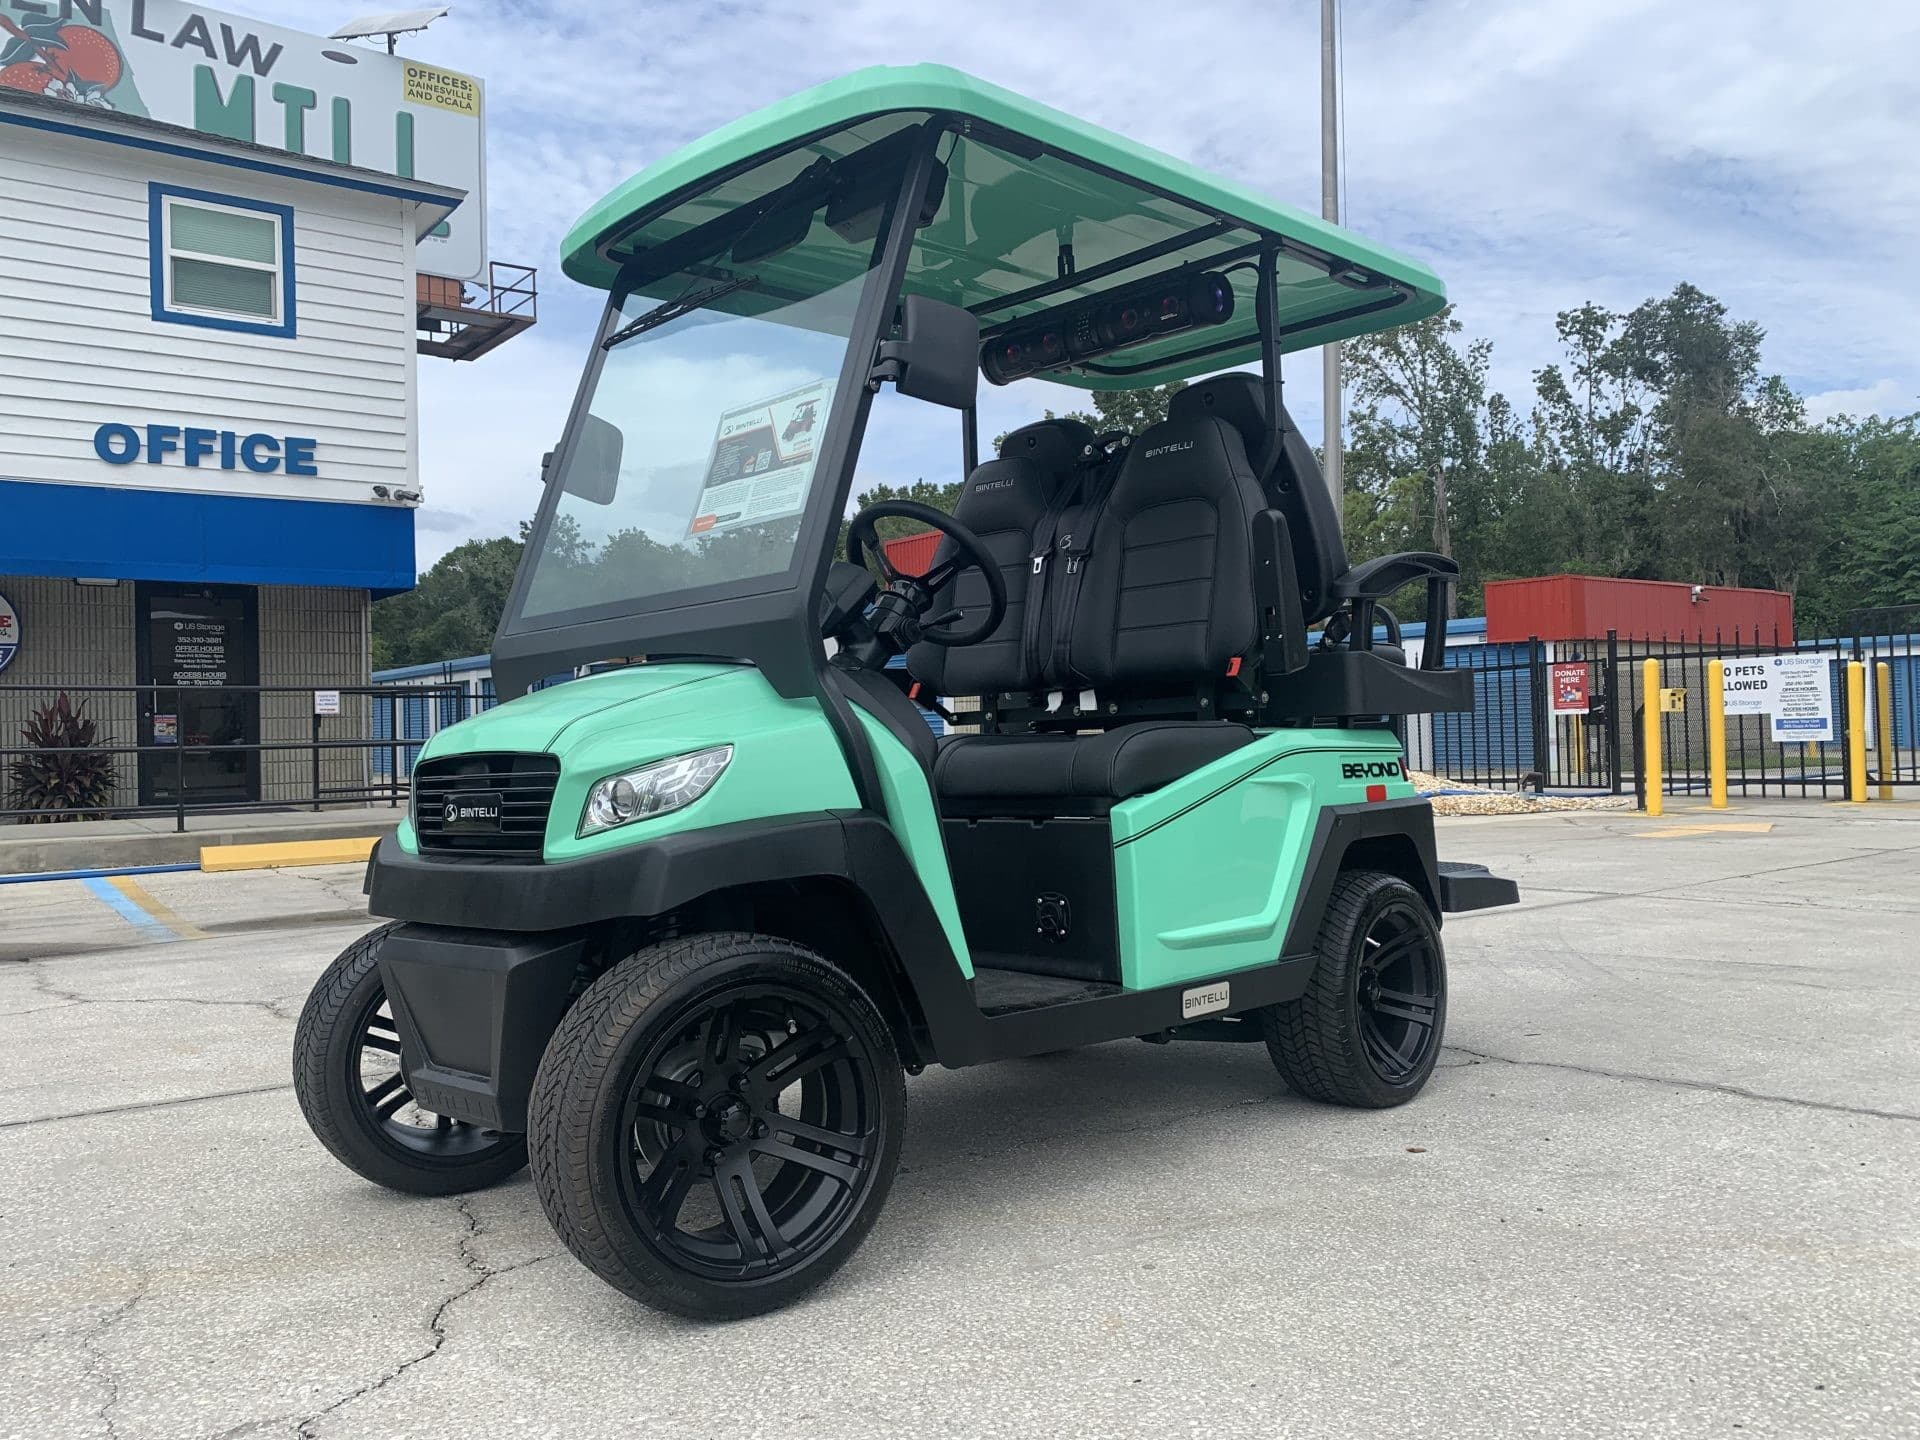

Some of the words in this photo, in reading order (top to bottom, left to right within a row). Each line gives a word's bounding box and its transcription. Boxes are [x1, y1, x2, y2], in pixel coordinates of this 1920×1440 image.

[131, 0, 283, 77] LAW
[407, 67, 472, 92] OFFICES:
[408, 79, 473, 101] GAINESVILLE
[407, 88, 432, 101] AND
[435, 95, 473, 111] OCALA
[94, 422, 318, 476] OFFICE
[1145, 440, 1194, 458] BINTELLI
[975, 479, 1015, 492] BINTELLI
[197, 623, 225, 632] Storage
[173, 671, 201, 679] ACCESS
[1555, 669, 1585, 677] DONATE
[1735, 665, 1765, 676] PETS
[1560, 676, 1580, 684] HERE
[1341, 762, 1399, 779] BEYOND
[460, 807, 498, 818] BINTELLI
[1185, 990, 1228, 1009] BINTELLI
